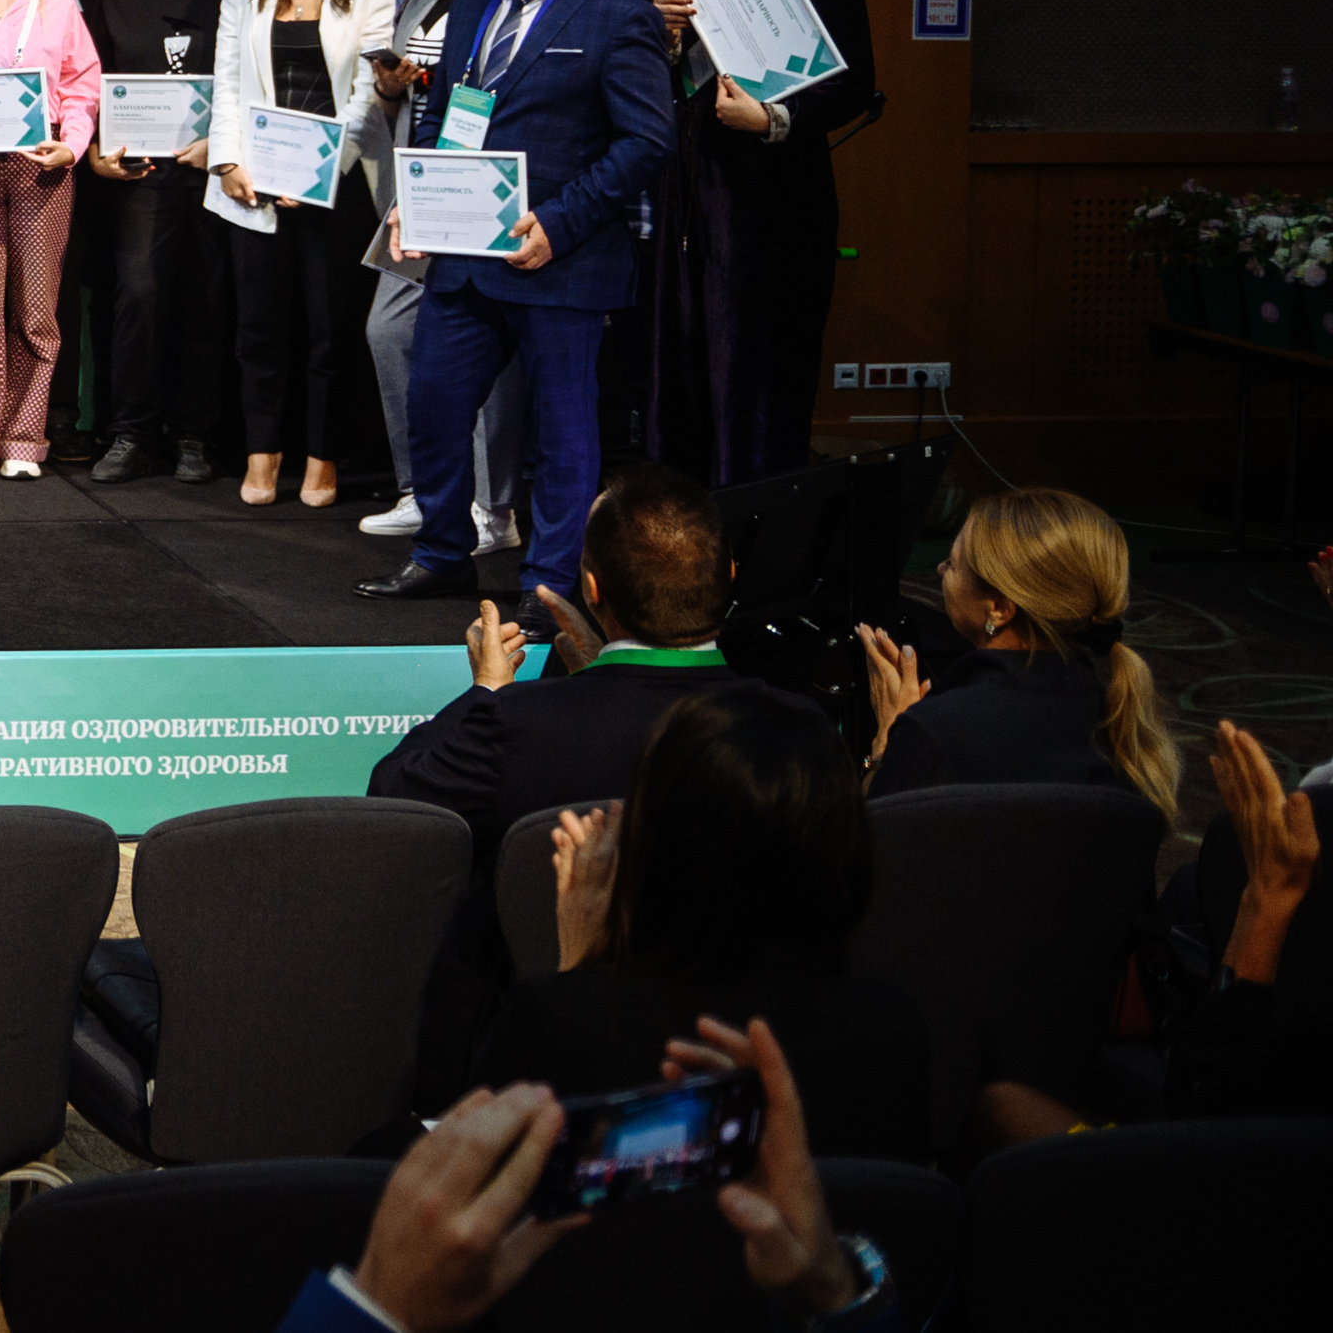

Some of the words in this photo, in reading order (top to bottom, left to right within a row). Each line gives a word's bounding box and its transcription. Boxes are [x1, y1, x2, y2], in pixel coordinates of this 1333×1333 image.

[72, 715, 339, 746] ОЗДОРОВИТЕЛЬНОГО
[344, 714, 435, 735] ТУРИ
[158, 753, 288, 780] ЗДОРОВЬЯ
